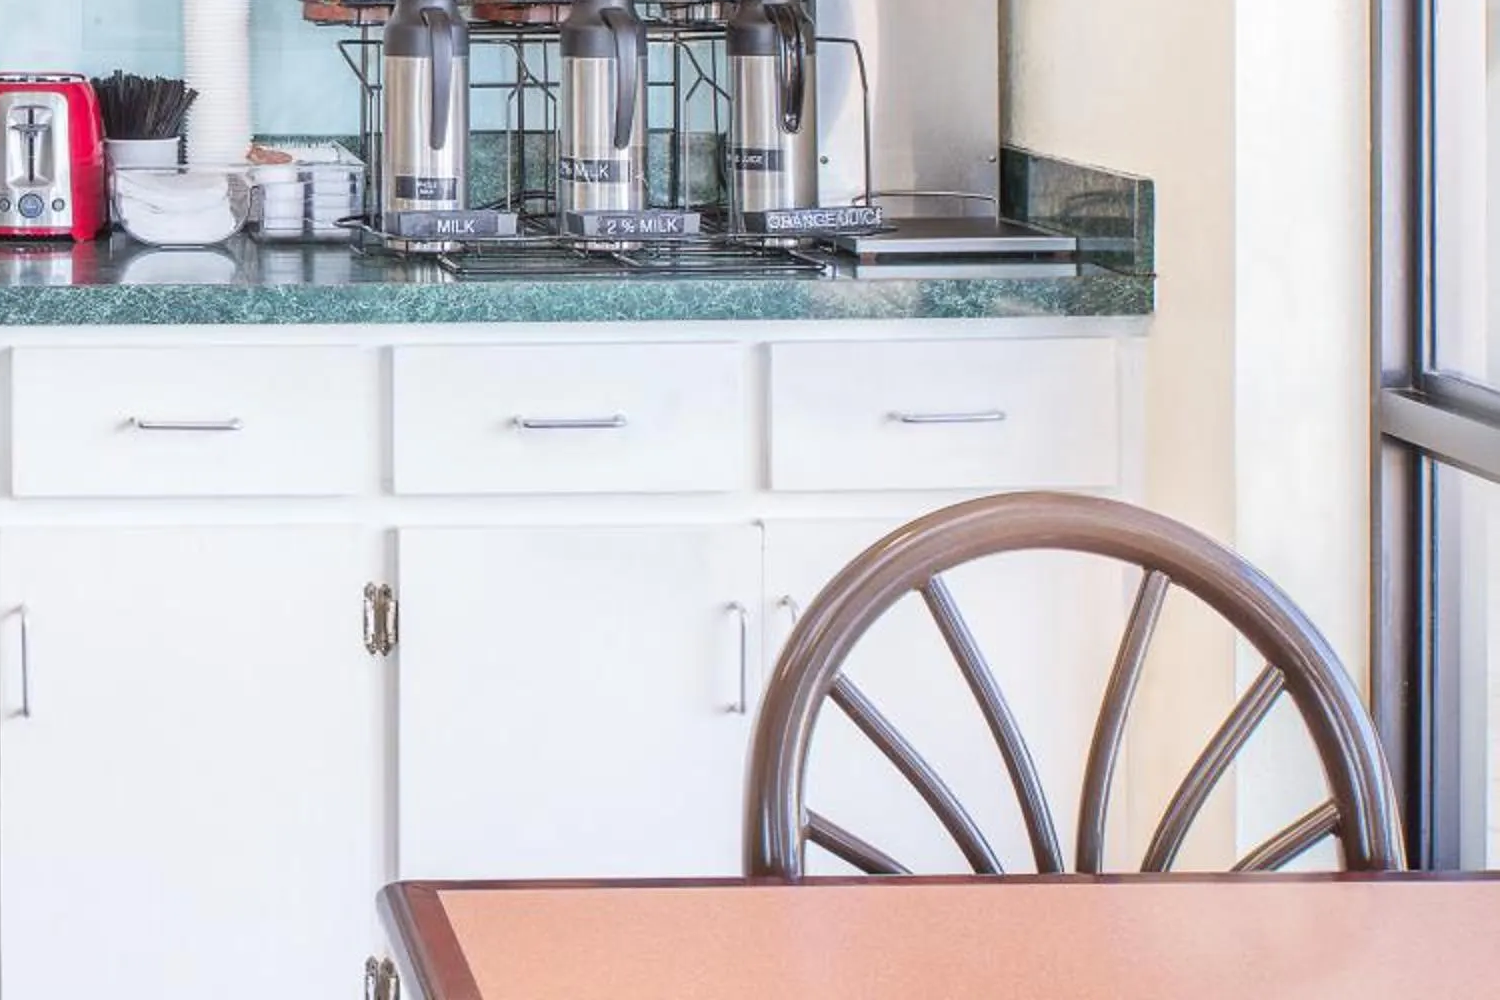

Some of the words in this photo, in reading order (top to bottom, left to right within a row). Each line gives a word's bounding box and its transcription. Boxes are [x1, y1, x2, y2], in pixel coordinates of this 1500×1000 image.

[437, 219, 476, 233] MILK
[607, 220, 617, 235] 2
[622, 219, 635, 233] %
[640, 218, 678, 233] MILK
[767, 210, 837, 230] ORANGE
[838, 206, 883, 227] JUICE
